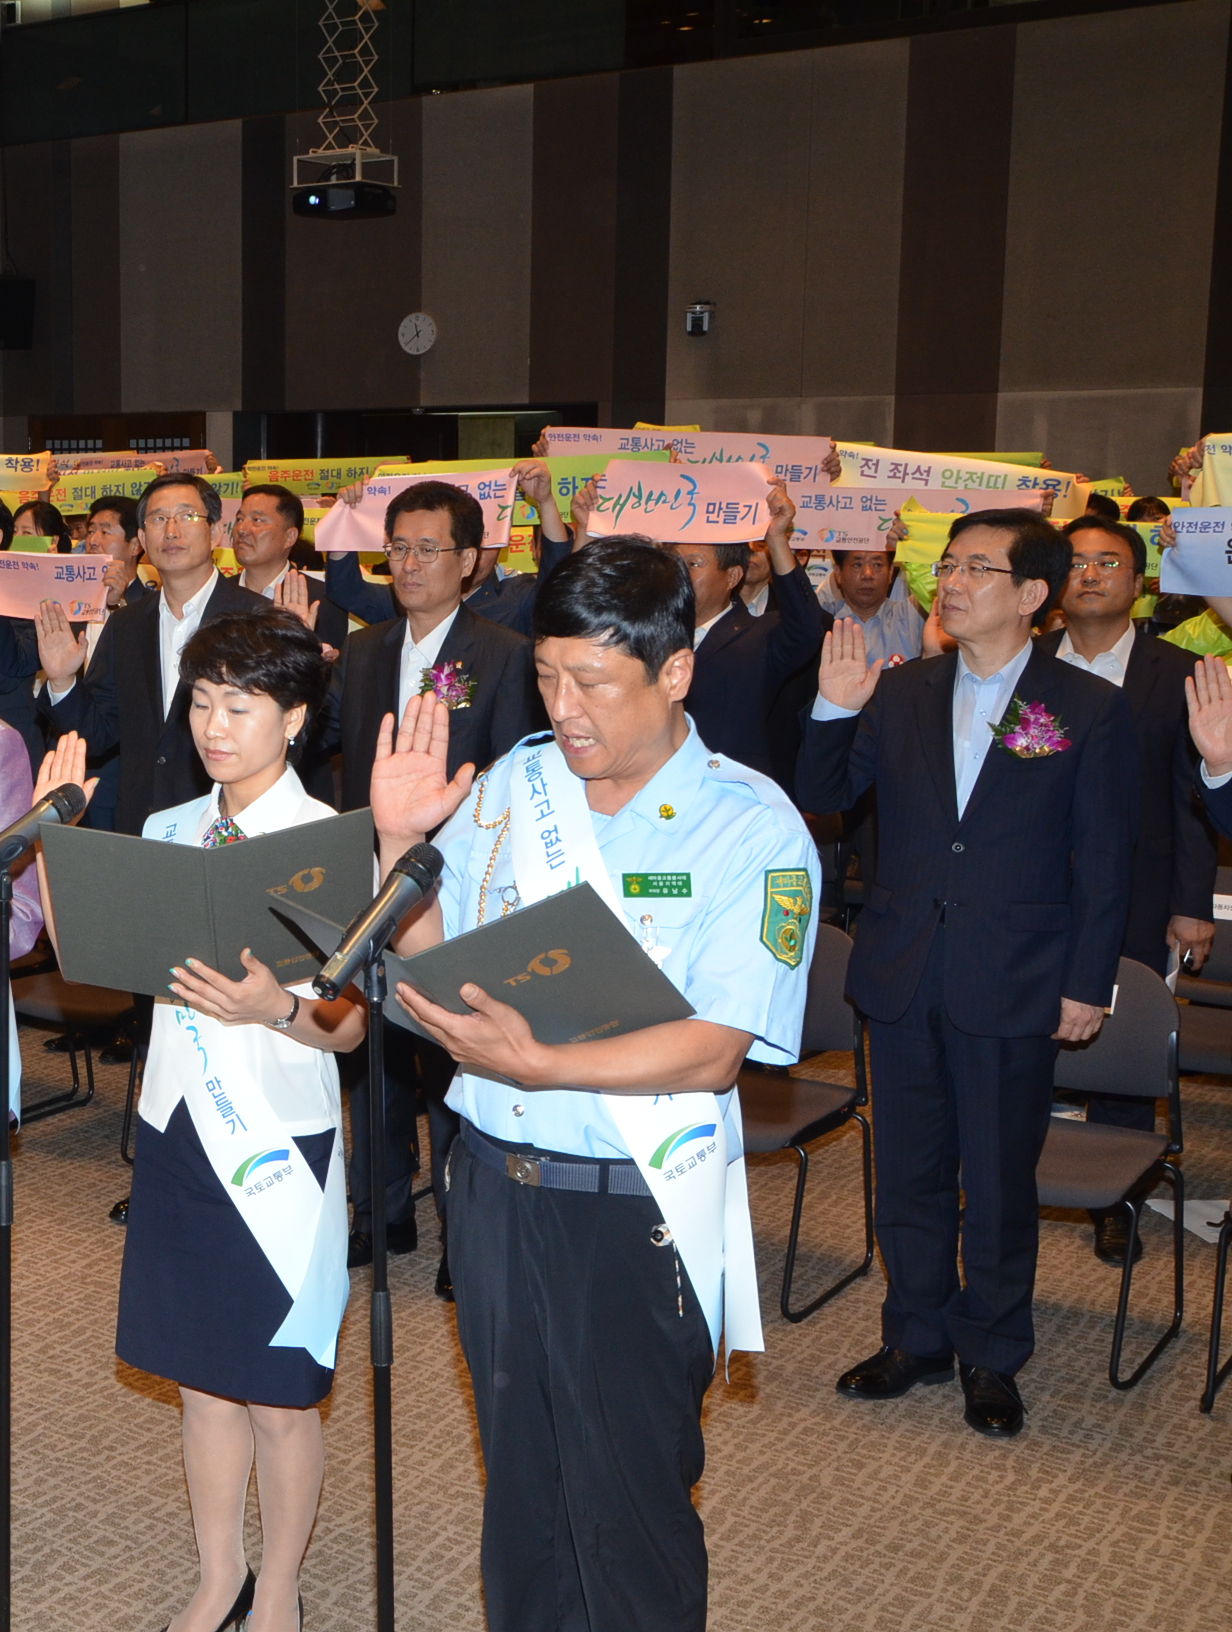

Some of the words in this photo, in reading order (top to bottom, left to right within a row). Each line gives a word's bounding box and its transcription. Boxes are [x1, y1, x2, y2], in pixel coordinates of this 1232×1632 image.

[548, 433, 580, 442] 안전운전
[583, 433, 602, 443] 약속!
[617, 436, 667, 453] 교통사고
[671, 438, 697, 455] 없는
[839, 449, 860, 460] 약속!
[4, 456, 41, 473] 착용!
[774, 464, 819, 483] 만들기
[858, 456, 881, 480] 전
[886, 461, 933, 487] 좌석
[940, 467, 1009, 491] 안전띠
[268, 468, 315, 483] 음주운전
[318, 468, 343, 481] 절대
[346, 466, 371, 480] 하지
[71, 485, 96, 501] 절대
[366, 485, 391, 497] 약속!
[476, 480, 507, 501] 없는
[595, 473, 701, 532] 대한민국
[705, 501, 760, 526] 만들기
[799, 493, 855, 512] 교통사고
[859, 494, 888, 513] 없는
[1172, 520, 1226, 534] 안전운전
[21, 561, 40, 572] 약속!
[54, 564, 98, 583] 교통사고
[539, 824, 567, 871] 없는
[265, 884, 288, 896] TS
[503, 971, 532, 987] TS
[205, 1075, 248, 1136] 만들기
[662, 1140, 718, 1182] 국토교통부
[243, 1164, 294, 1198] 국토교통부
